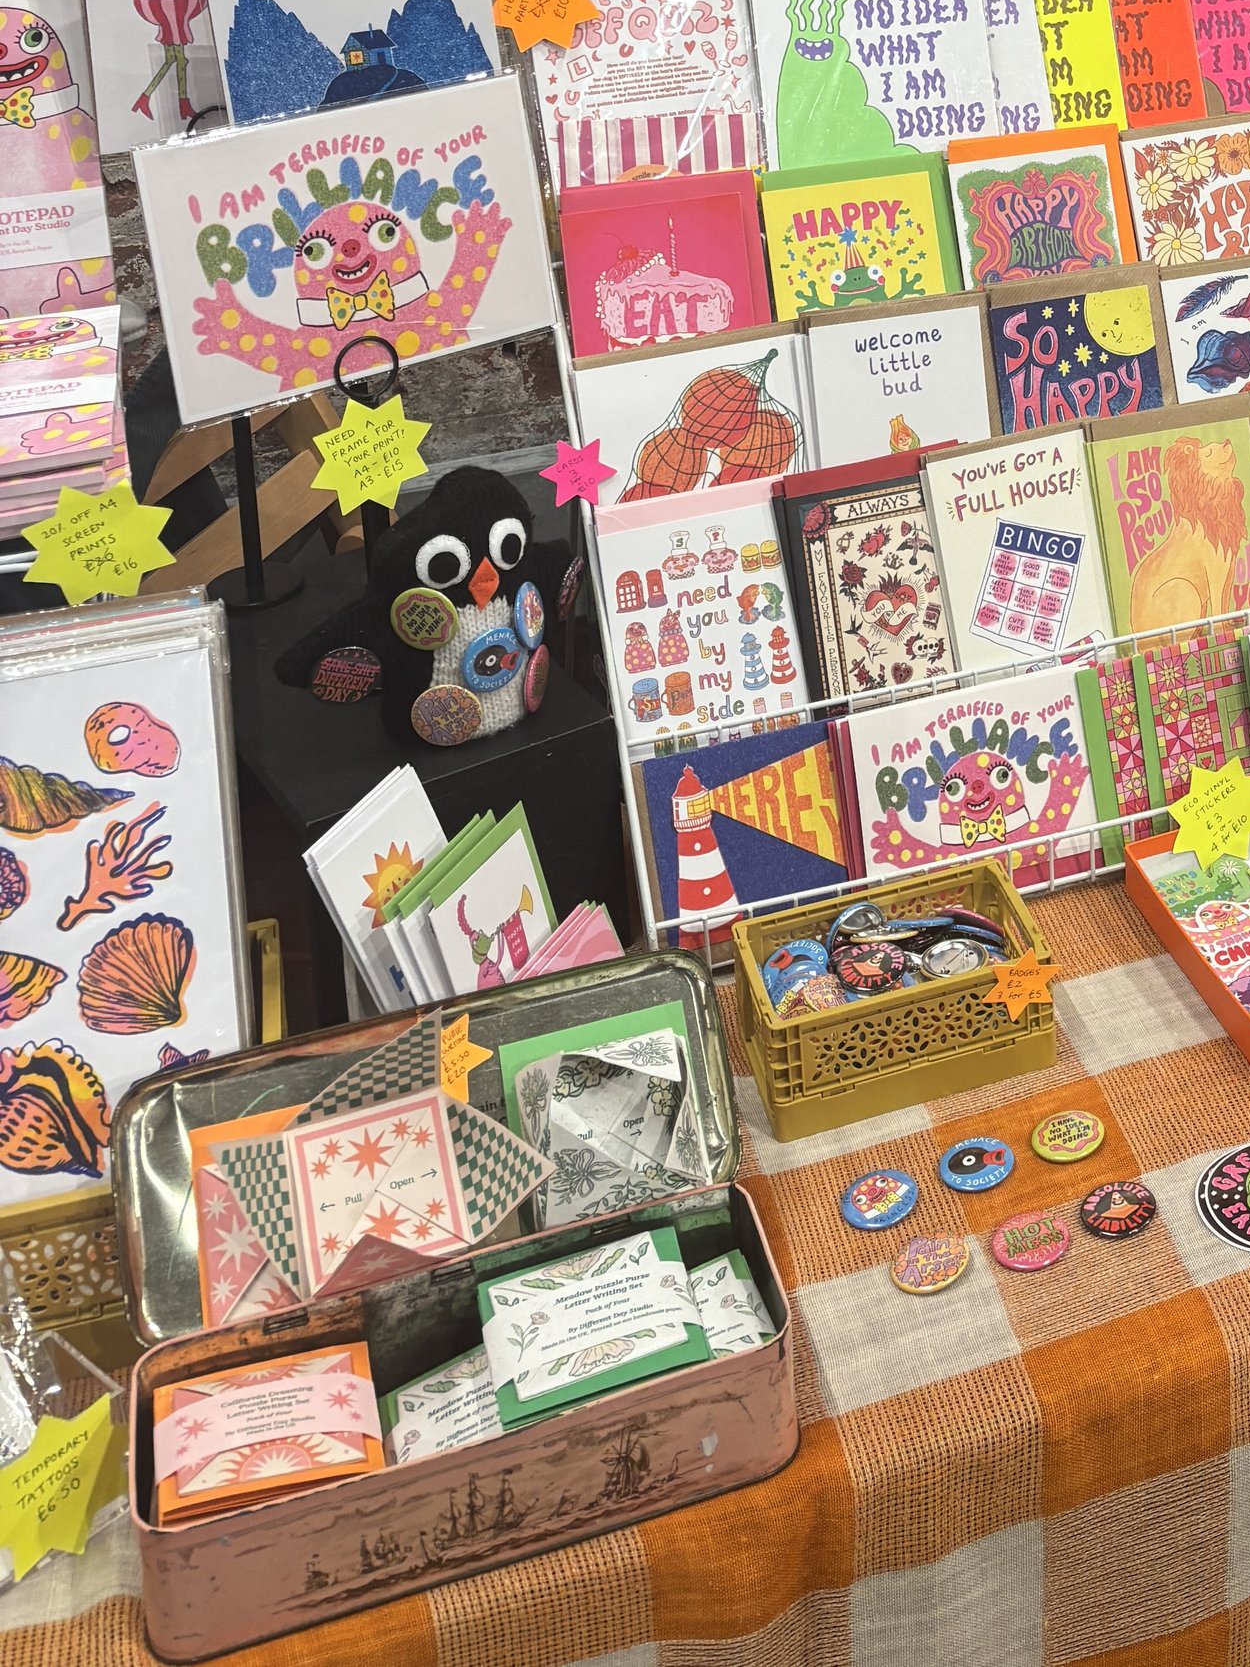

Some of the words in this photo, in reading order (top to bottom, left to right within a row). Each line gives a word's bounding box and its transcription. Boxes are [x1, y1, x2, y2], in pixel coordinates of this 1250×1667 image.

[856, 31, 942, 67] WHAT
[881, 72, 893, 102] I
[905, 68, 946, 100] AM
[896, 102, 985, 139] DOING
[188, 195, 201, 223] I
[220, 184, 265, 218] AM
[269, 135, 385, 184] TERRIFIED
[397, 148, 423, 166] OF
[435, 125, 487, 162] YOUR
[792, 199, 902, 242] HAPPY
[992, 186, 1080, 232] HAPPY
[196, 155, 494, 297] BRILLIANCE
[1010, 220, 1076, 269] BIRTHDAY
[624, 293, 710, 336] EAT
[855, 326, 942, 354] welcome
[1004, 310, 1059, 374] SO
[869, 351, 931, 375] little
[882, 377, 923, 396] bud
[1009, 357, 1142, 434] HAPPY
[325, 429, 355, 449] NEED
[365, 420, 375, 429] A
[332, 435, 370, 461] FRAME
[375, 419, 395, 436] FOR
[344, 450, 371, 467] YOUR
[372, 429, 405, 453] PRINT?
[952, 459, 1007, 490] YOU'VE
[1013, 450, 1047, 472] GOT
[1052, 447, 1063, 466] A
[1107, 453, 1124, 501] I
[1126, 446, 1162, 481] AM
[847, 494, 909, 518] ALWAYS
[953, 489, 1005, 522] FULL
[1009, 468, 1075, 507] HOUSE!
[1126, 471, 1162, 520] SO
[70, 509, 91, 524] OFF
[100, 498, 117, 512] A4
[62, 521, 104, 547] SCREEN
[70, 534, 116, 561] PRINTS
[1001, 526, 1076, 559] BINGO
[1117, 500, 1173, 578] PROUD
[113, 557, 138, 576] £16
[677, 575, 732, 608] need
[687, 609, 729, 638] you
[698, 638, 726, 665] by
[698, 670, 732, 692] my
[696, 694, 745, 723] side
[1183, 797, 1199, 812] ECO
[1204, 777, 1231, 796] VINYL
[1195, 784, 1236, 820] STICKERS
[851, 942, 905, 971] ABSOLUTE
[1009, 968, 1041, 977] BADGES
[623, 1115, 644, 1129] Open
[954, 1136, 999, 1150] MENACE
[389, 1175, 415, 1191] Open
[951, 1175, 962, 1184] TO
[965, 1166, 1006, 1186] SOCIETY
[344, 1192, 363, 1206] Pull
[1082, 1182, 1149, 1212] ABSOLUTE
[1004, 1218, 1056, 1241] HOT
[1087, 1201, 1154, 1232] LIABILITY
[1007, 1233, 1064, 1258] MESS
[555, 1288, 593, 1305] Meadow
[595, 1279, 623, 1291] Puzzle
[625, 1273, 650, 1283] Purse
[564, 1298, 591, 1310] Letter
[593, 1288, 627, 1301] Writing
[629, 1282, 643, 1290] Set
[12, 1430, 88, 1490] TEMPORARY
[16, 1456, 79, 1509] TATTOOS
